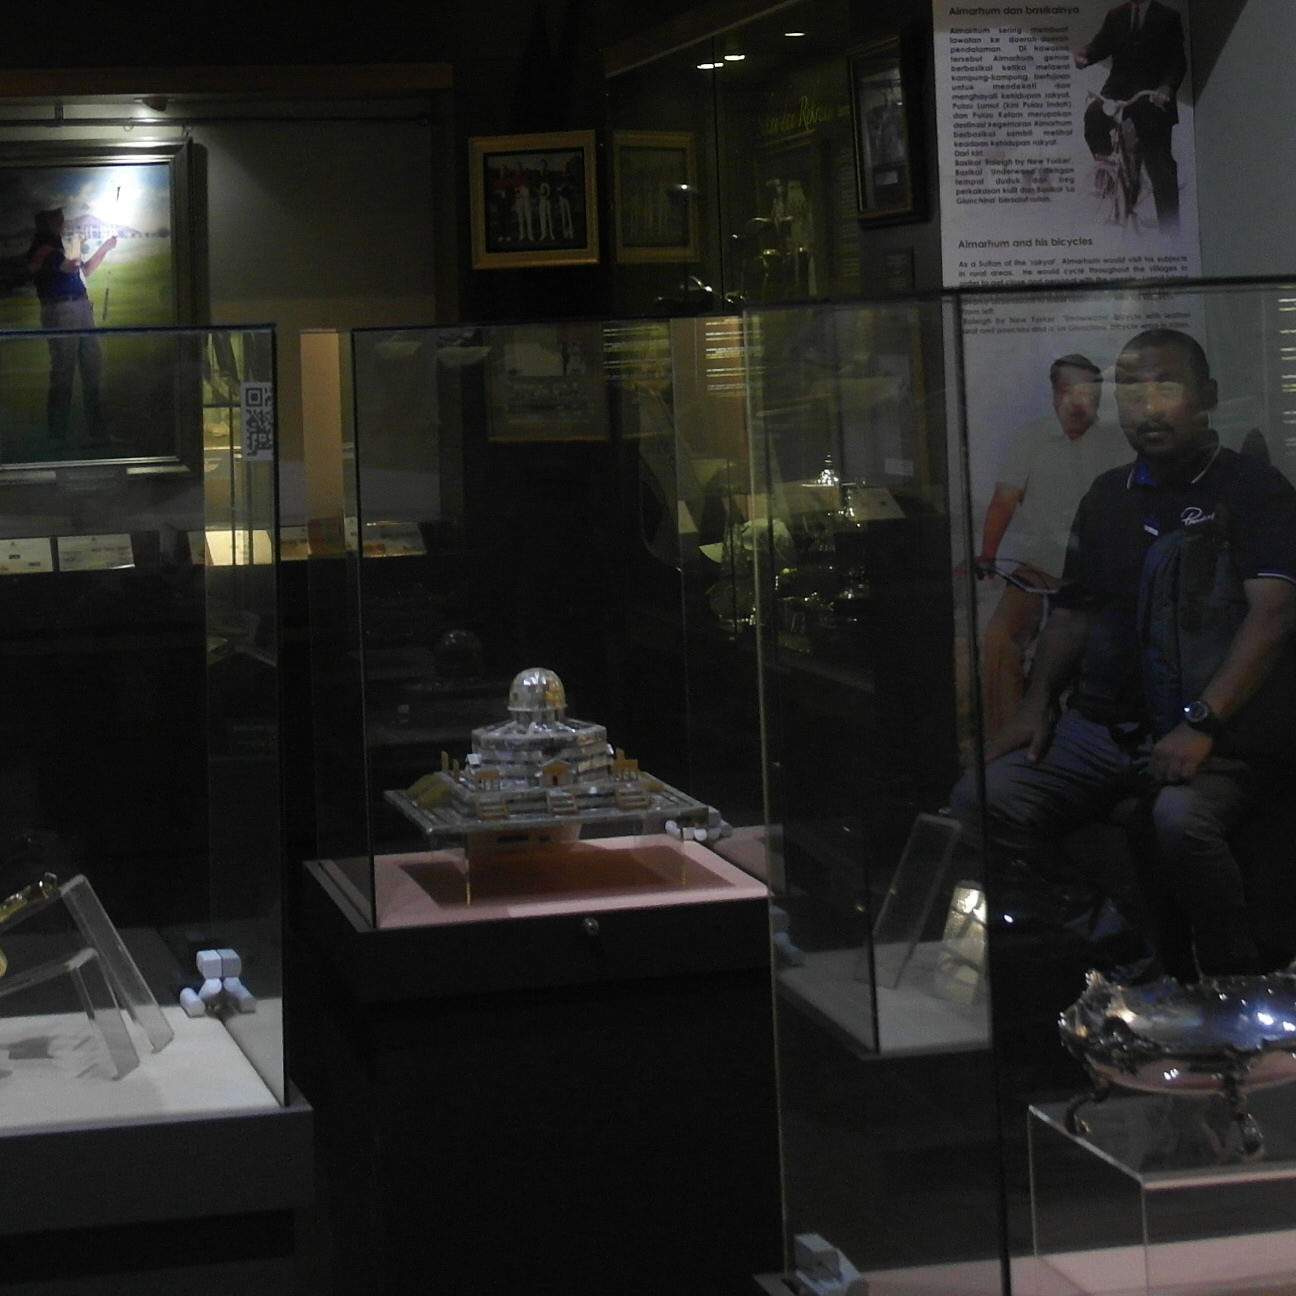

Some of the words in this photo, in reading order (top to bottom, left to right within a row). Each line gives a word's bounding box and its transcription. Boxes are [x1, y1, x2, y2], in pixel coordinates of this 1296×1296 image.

[949, 7, 1000, 16] Almarhum
[1026, 7, 1079, 16] basikalnya
[1034, 73, 1070, 81] bertujuan
[952, 93, 998, 101] menghayati
[1003, 102, 1019, 110] (kini
[988, 121, 1031, 129] kegemaran
[1044, 167, 1074, 175] dengan
[956, 178, 984, 186] tempat
[956, 188, 1000, 196] perkakasan
[999, 196, 1029, 204] bersalut
[959, 239, 1010, 249] Almarhum
[1012, 238, 1032, 248] and
[1035, 237, 1048, 246] his
[1051, 237, 1093, 247] bicycles
